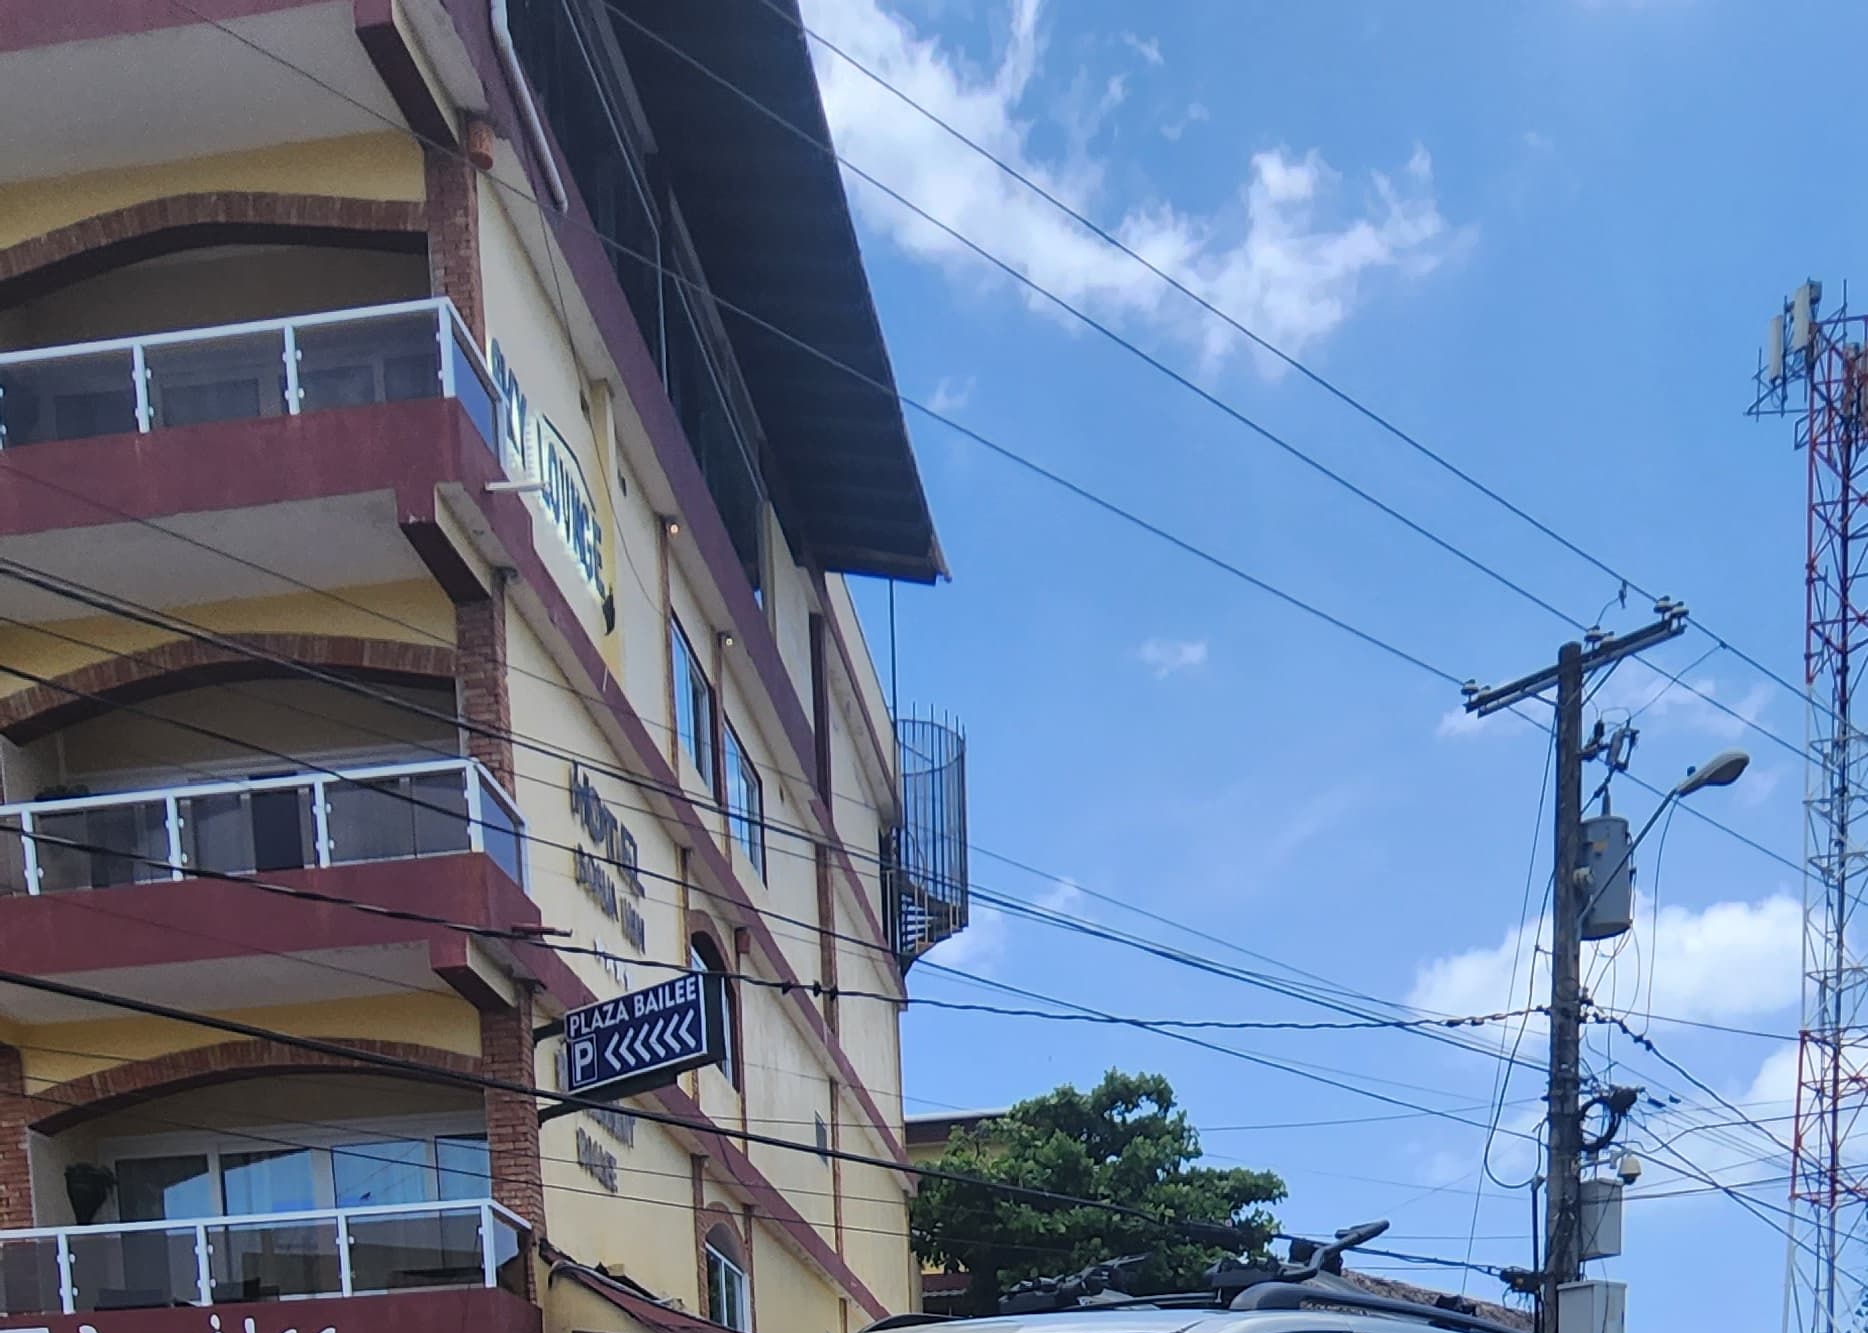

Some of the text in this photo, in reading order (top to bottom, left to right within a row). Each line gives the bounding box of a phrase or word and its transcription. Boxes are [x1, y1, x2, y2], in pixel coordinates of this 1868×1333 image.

[536, 416, 606, 601] LOUNGE
[570, 760, 646, 899] HOTEL
[569, 975, 697, 1038] PLAZA BAILEE
[573, 1040, 594, 1082] P
